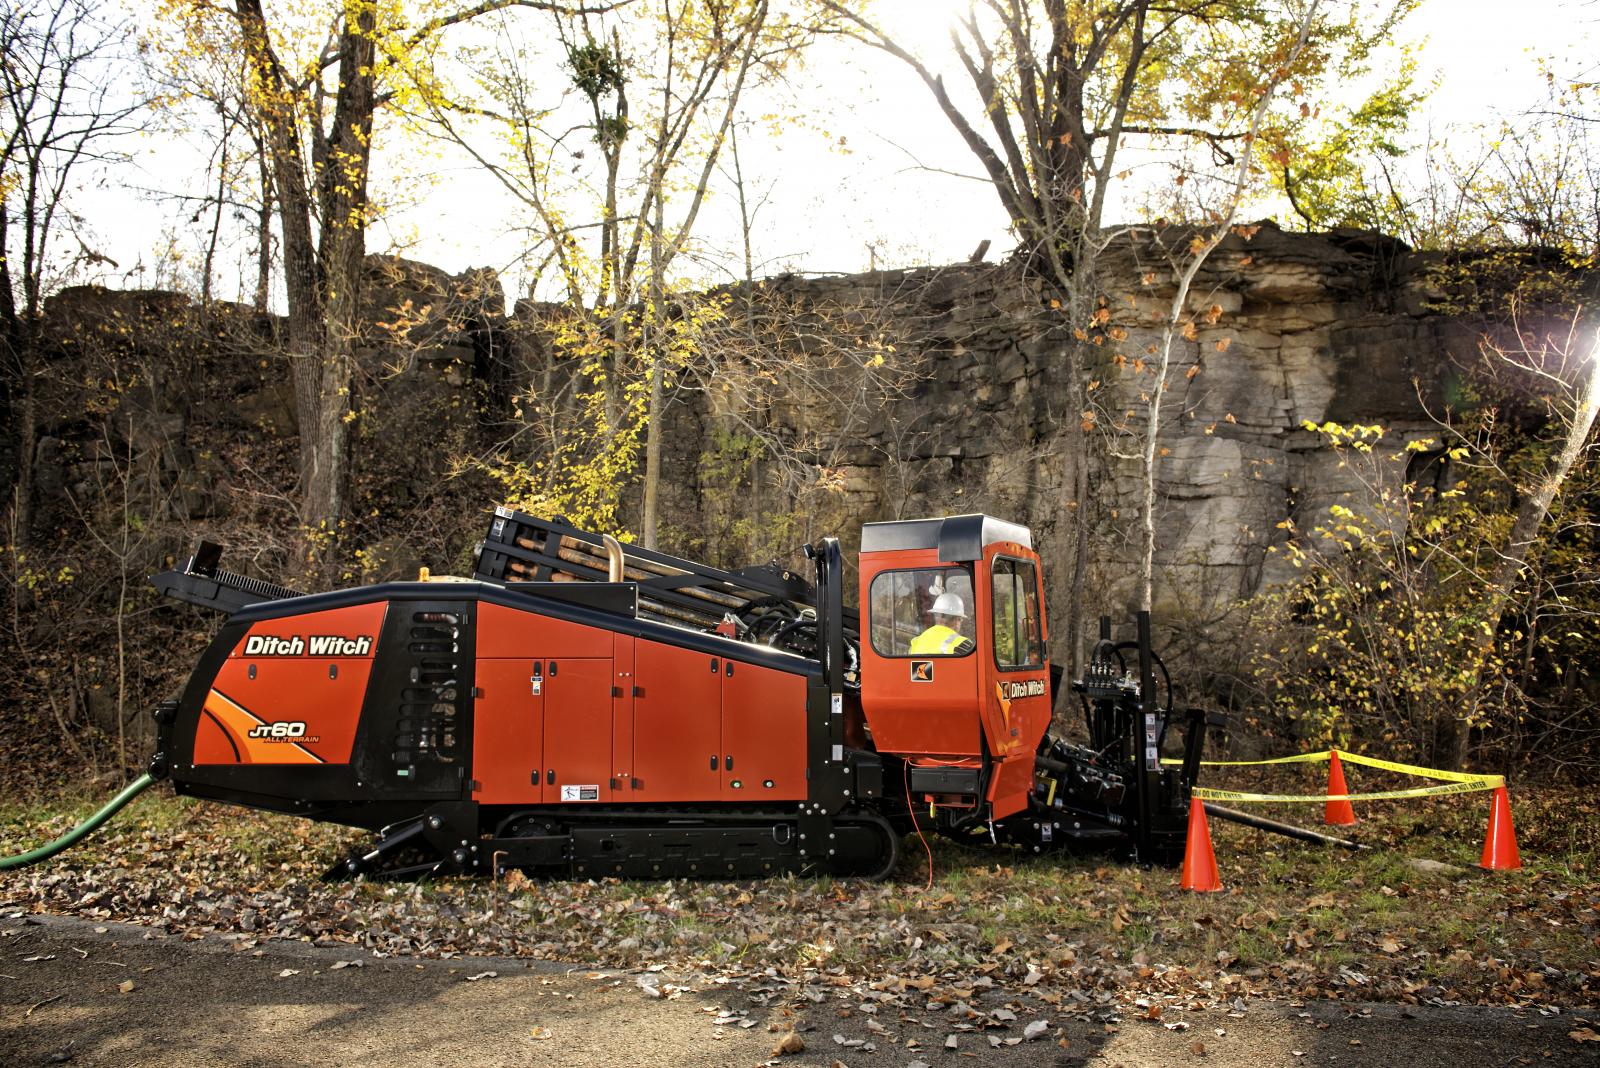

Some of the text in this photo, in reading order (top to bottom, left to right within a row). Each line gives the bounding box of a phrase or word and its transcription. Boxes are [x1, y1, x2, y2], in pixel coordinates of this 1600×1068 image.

[244, 635, 371, 655] Ditch Witch
[1011, 680, 1045, 698] Ditch Witch
[249, 721, 306, 738] JT60
[1469, 780, 1488, 790] ENTER
[1202, 789, 1210, 798] DO
[1211, 790, 1222, 799] NOT
